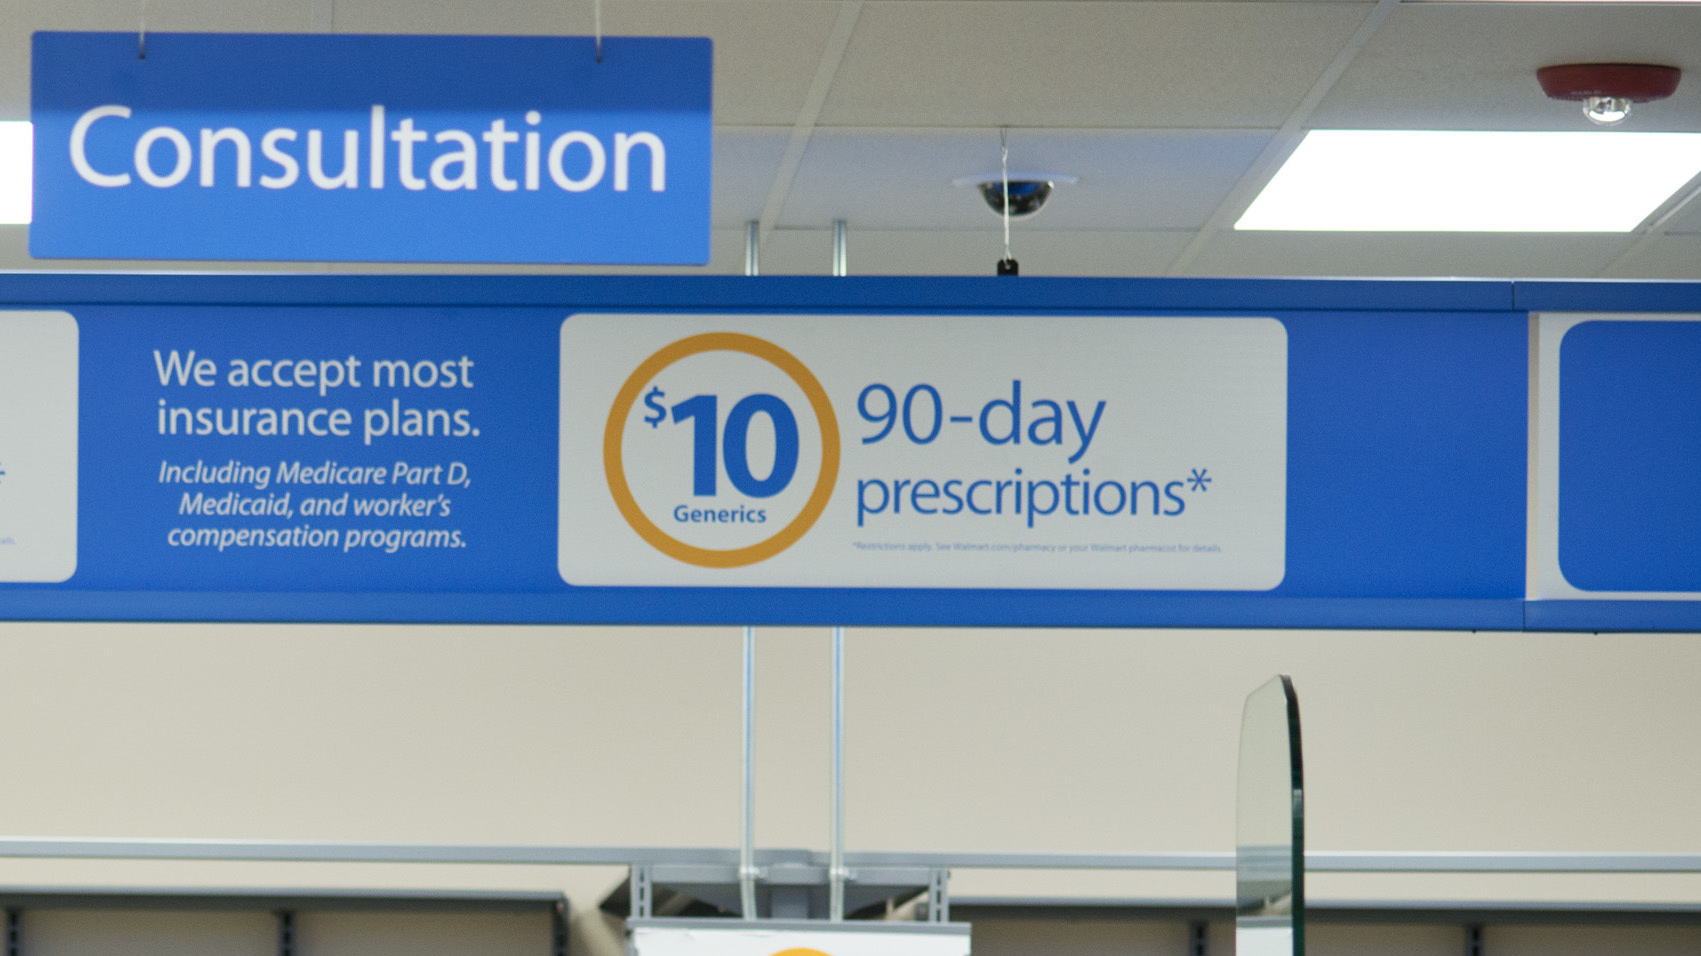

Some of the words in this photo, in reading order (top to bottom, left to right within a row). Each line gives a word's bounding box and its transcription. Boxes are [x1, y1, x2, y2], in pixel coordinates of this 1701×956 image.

[70, 104, 666, 192] Consultation
[153, 349, 217, 387] We
[227, 355, 361, 397] accept
[373, 355, 475, 388] most
[158, 399, 352, 436] insurance
[364, 398, 481, 446] plans.
[643, 385, 800, 499] $10
[856, 379, 1107, 465] 90-day
[158, 460, 272, 490] Including
[275, 460, 387, 485] Medicare
[391, 461, 443, 485] Part
[447, 461, 472, 489] D,
[179, 492, 294, 519] Medicaid,
[299, 493, 349, 517] and
[352, 493, 452, 517] worker's
[672, 504, 767, 524] Generics
[167, 525, 340, 552] compensation
[343, 528, 467, 554] programs.
